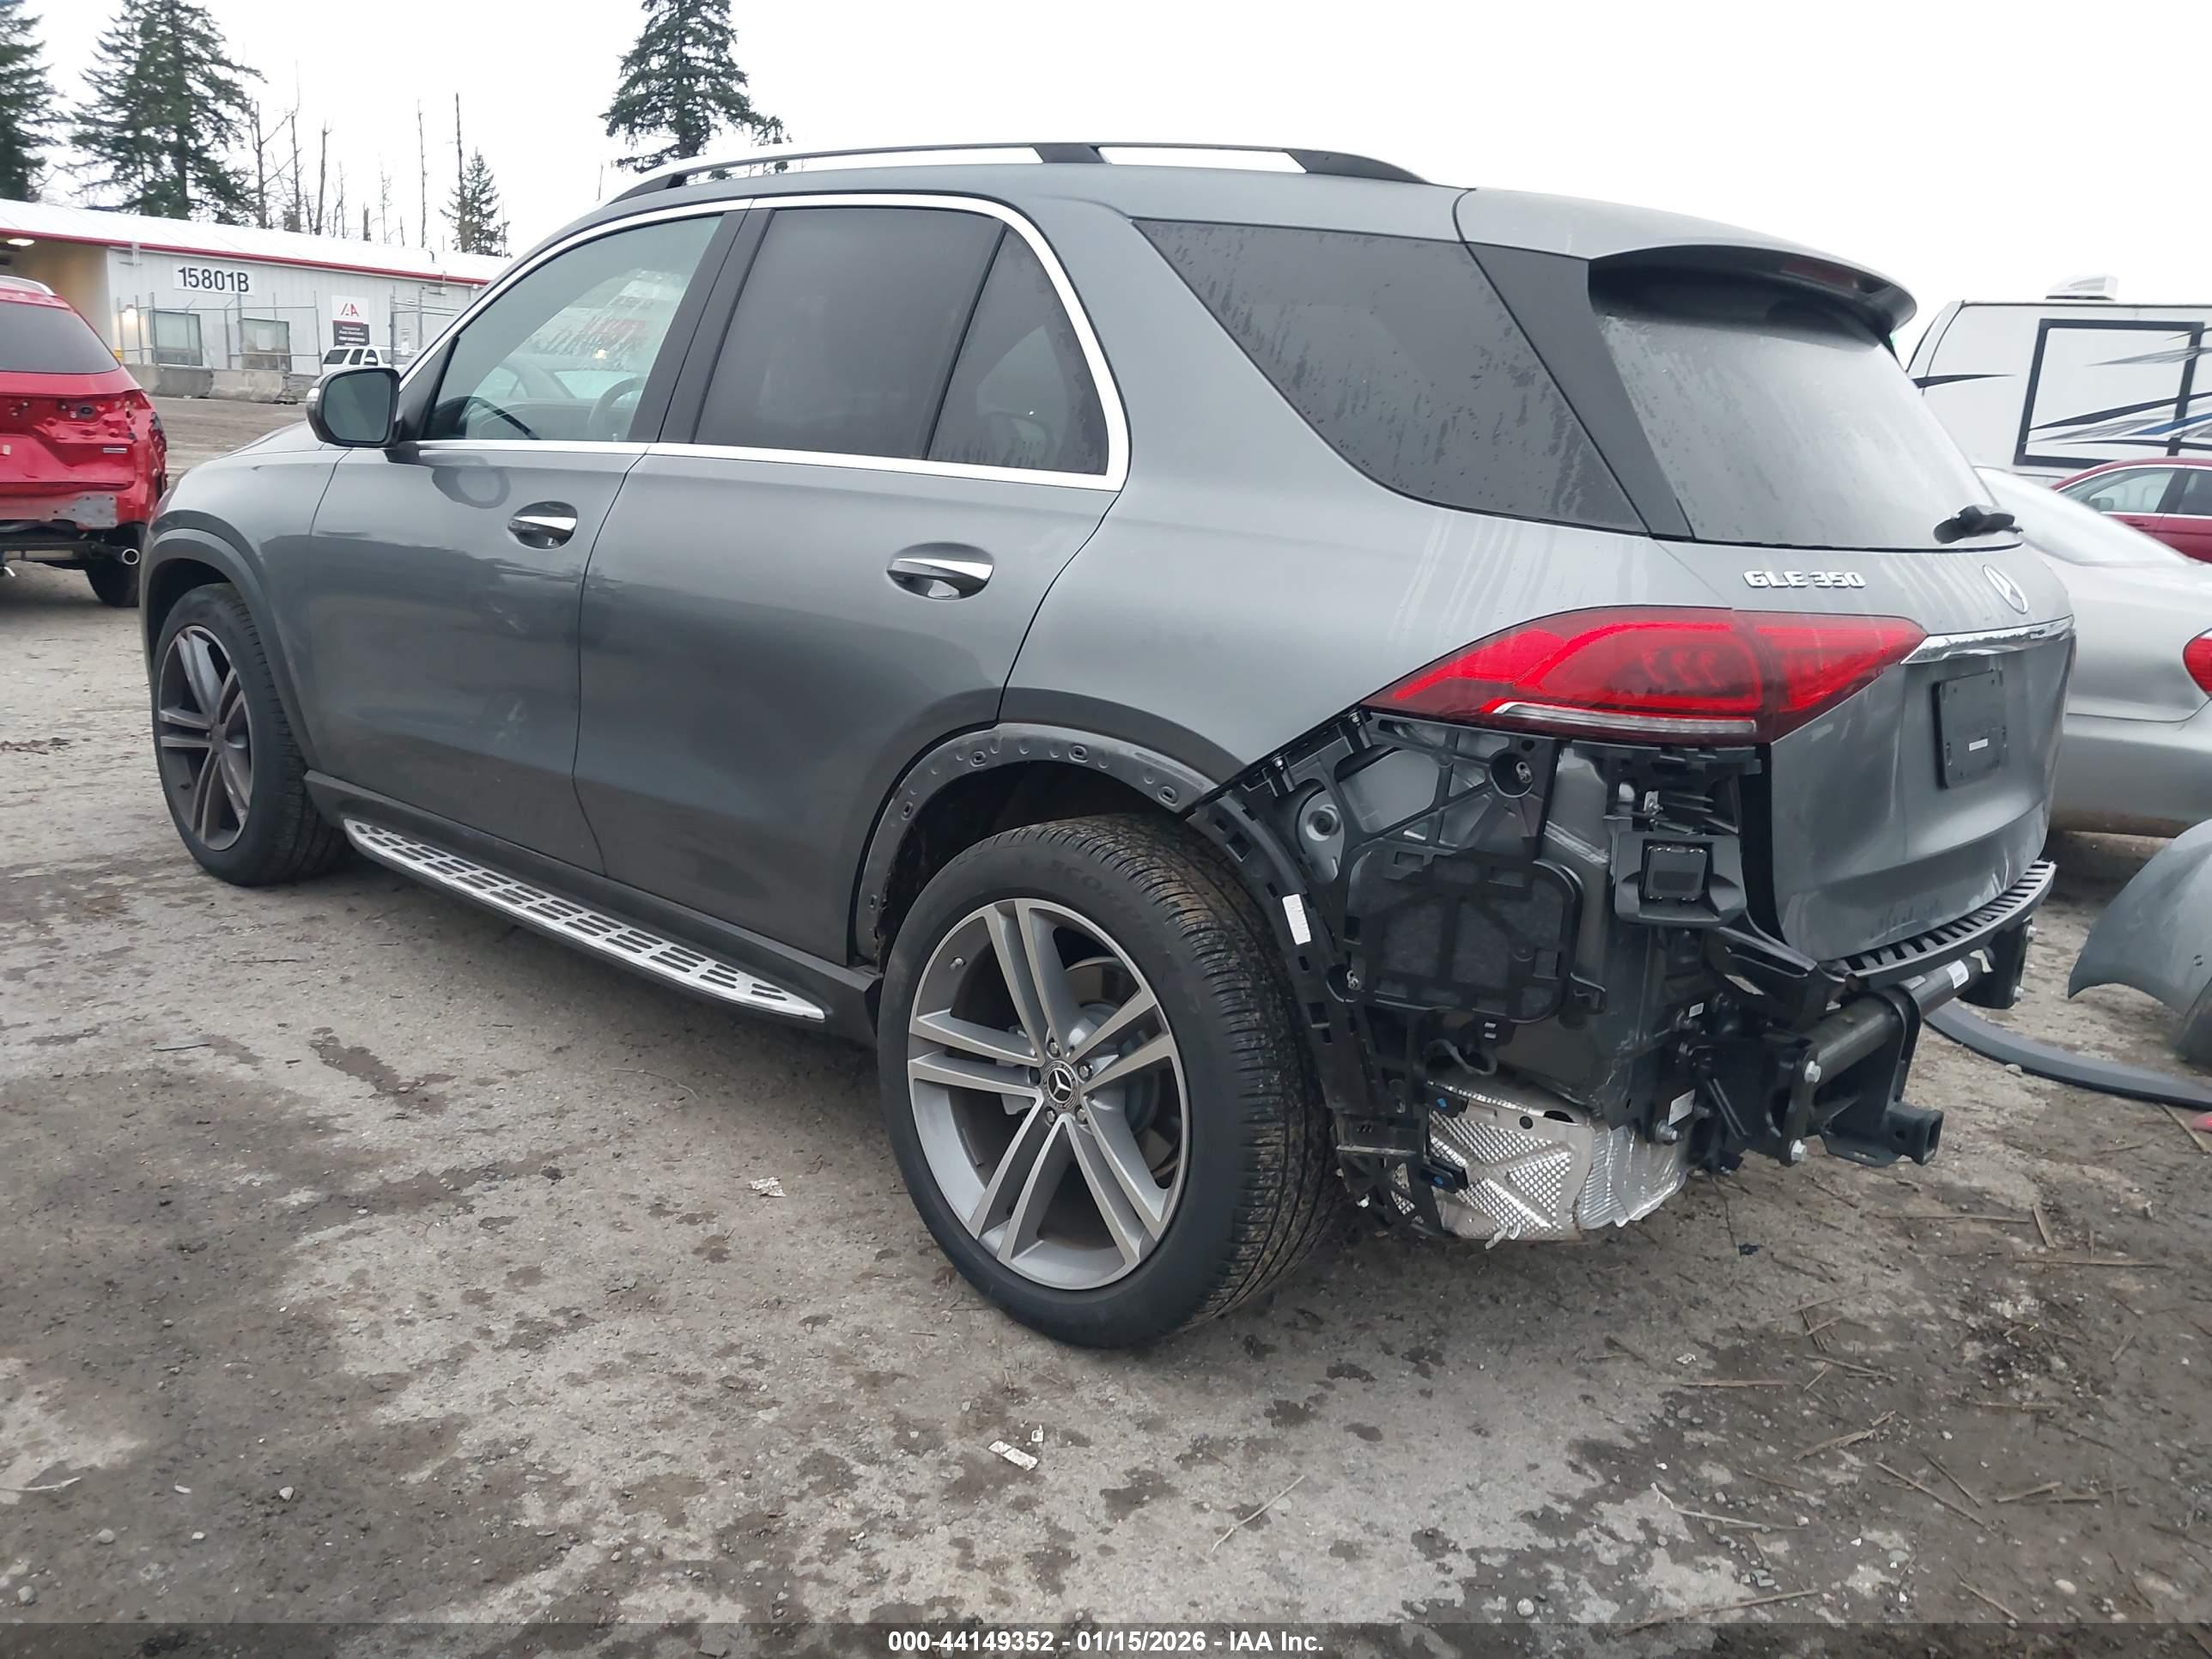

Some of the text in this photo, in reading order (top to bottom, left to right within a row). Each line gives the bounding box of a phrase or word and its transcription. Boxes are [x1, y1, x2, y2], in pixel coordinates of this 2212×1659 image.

[178, 267, 249, 293] 15801B
[1744, 570, 1867, 589] GLE 350
